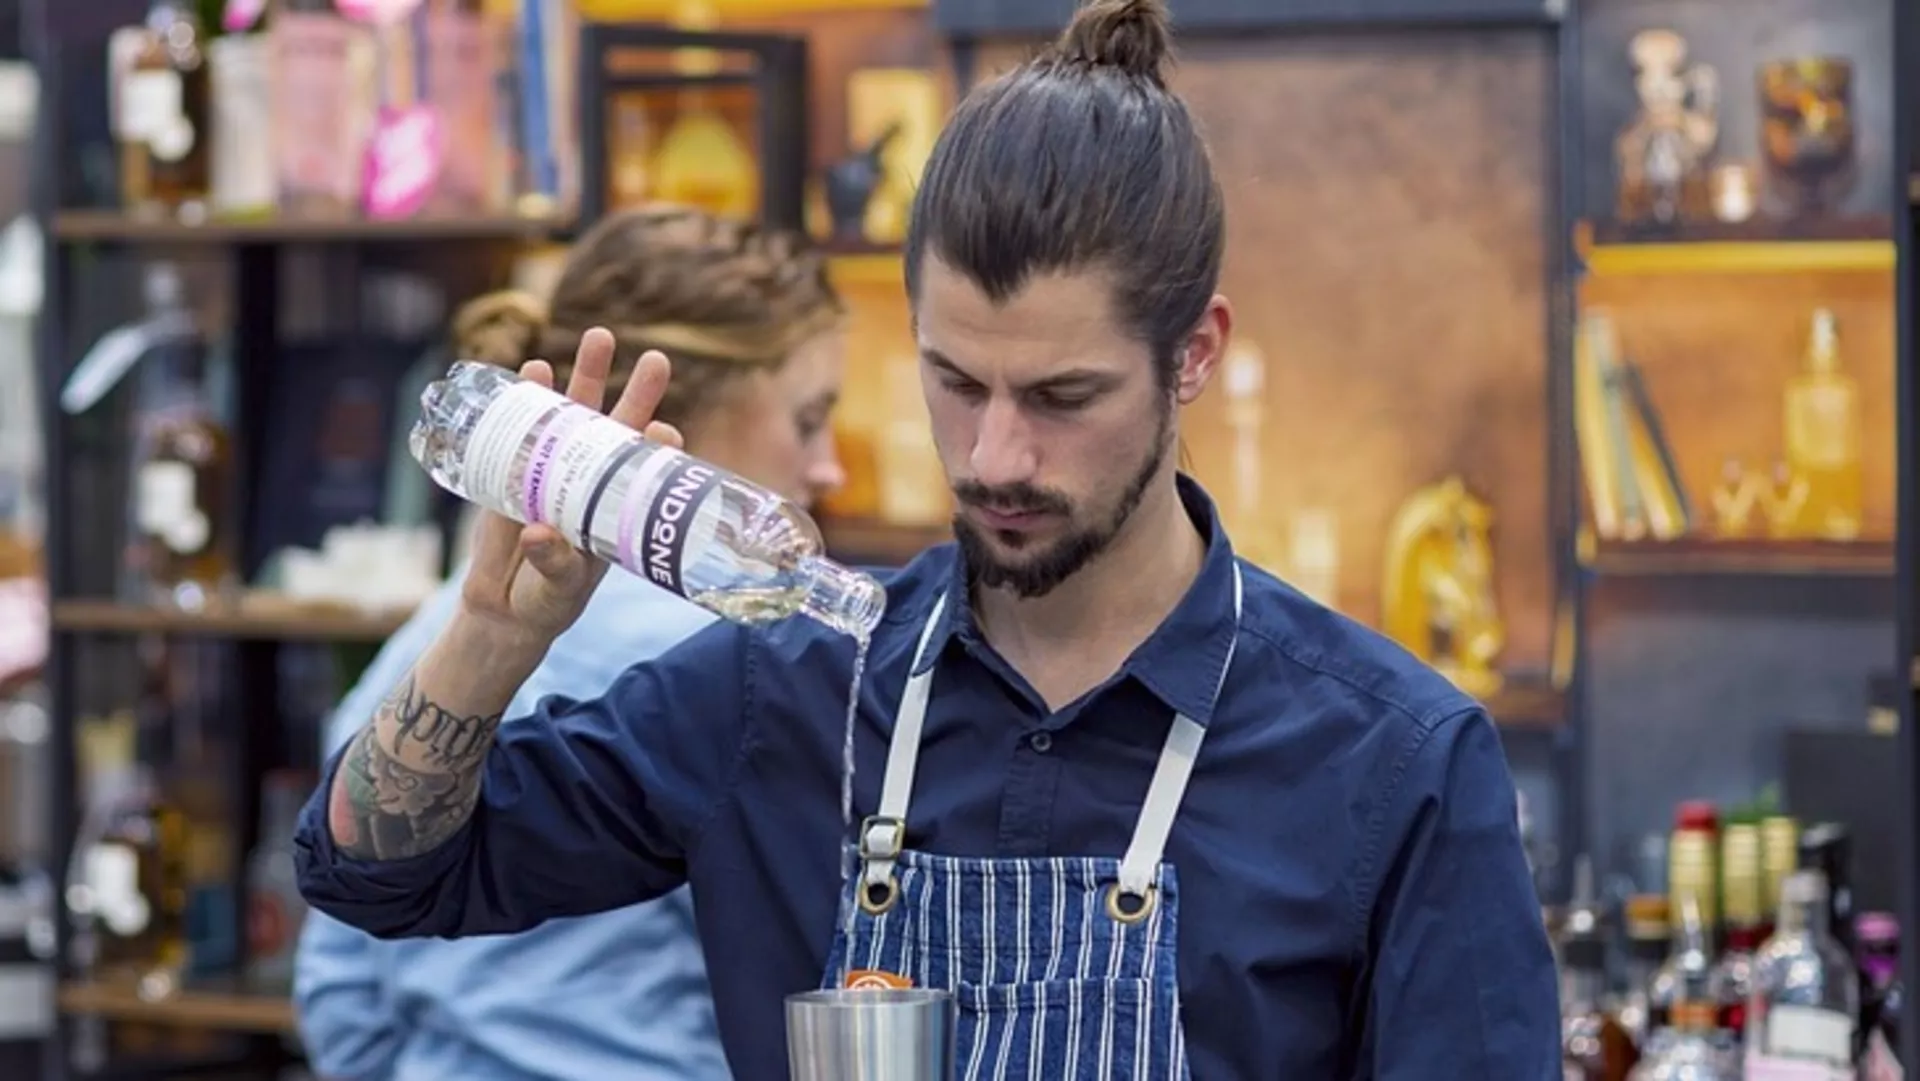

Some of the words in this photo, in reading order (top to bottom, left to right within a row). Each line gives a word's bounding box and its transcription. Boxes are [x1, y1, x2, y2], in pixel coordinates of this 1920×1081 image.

[539, 435, 559, 459] NOT
[528, 461, 546, 522] VERMOU
[649, 464, 715, 586] UNDONE
